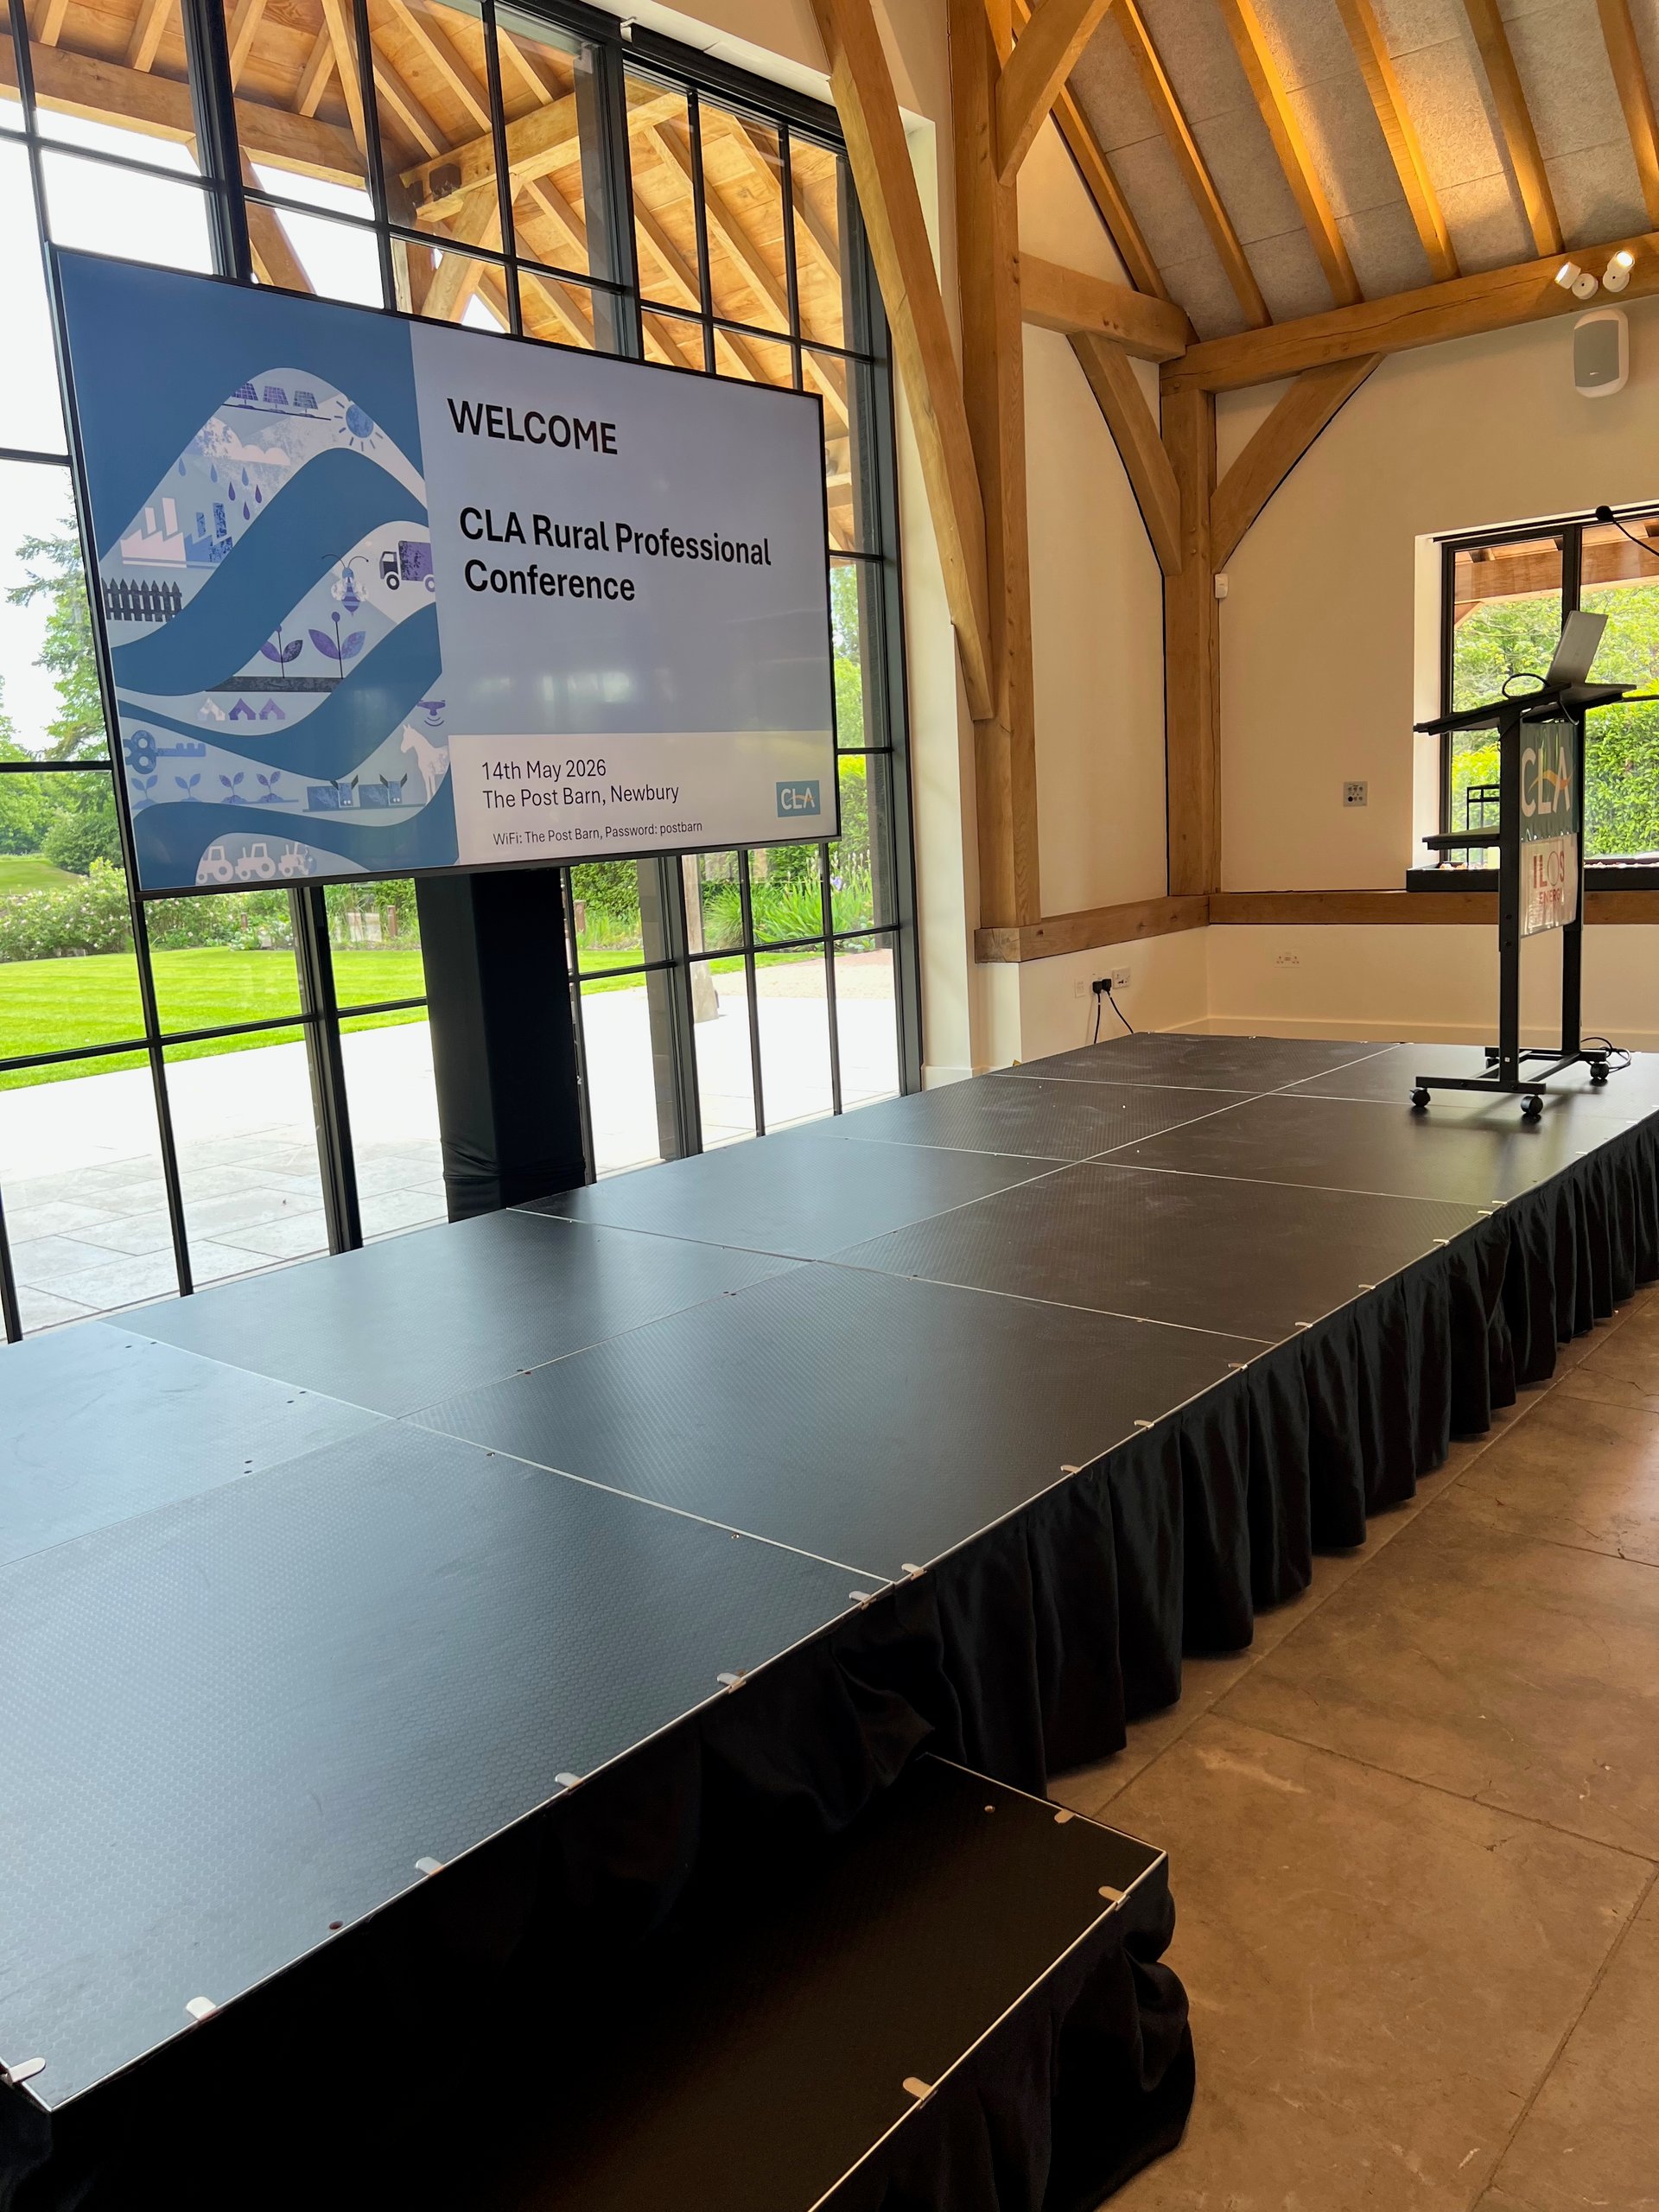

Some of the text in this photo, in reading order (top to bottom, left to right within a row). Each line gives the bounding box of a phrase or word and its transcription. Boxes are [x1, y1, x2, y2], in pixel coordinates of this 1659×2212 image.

[448, 397, 618, 454] WELCOME
[460, 507, 772, 566] CLA Rural Professional
[464, 559, 635, 601] Conference
[482, 759, 607, 782] 14th May 2026
[1521, 746, 1571, 817] CLA
[482, 784, 679, 809] The Post Barn, Newbury
[780, 787, 816, 810] CLA
[493, 821, 702, 846] WiFi: The Post Barn, Password: postbarn
[1533, 850, 1565, 889] ILOS
[1539, 888, 1563, 905] ENERG
